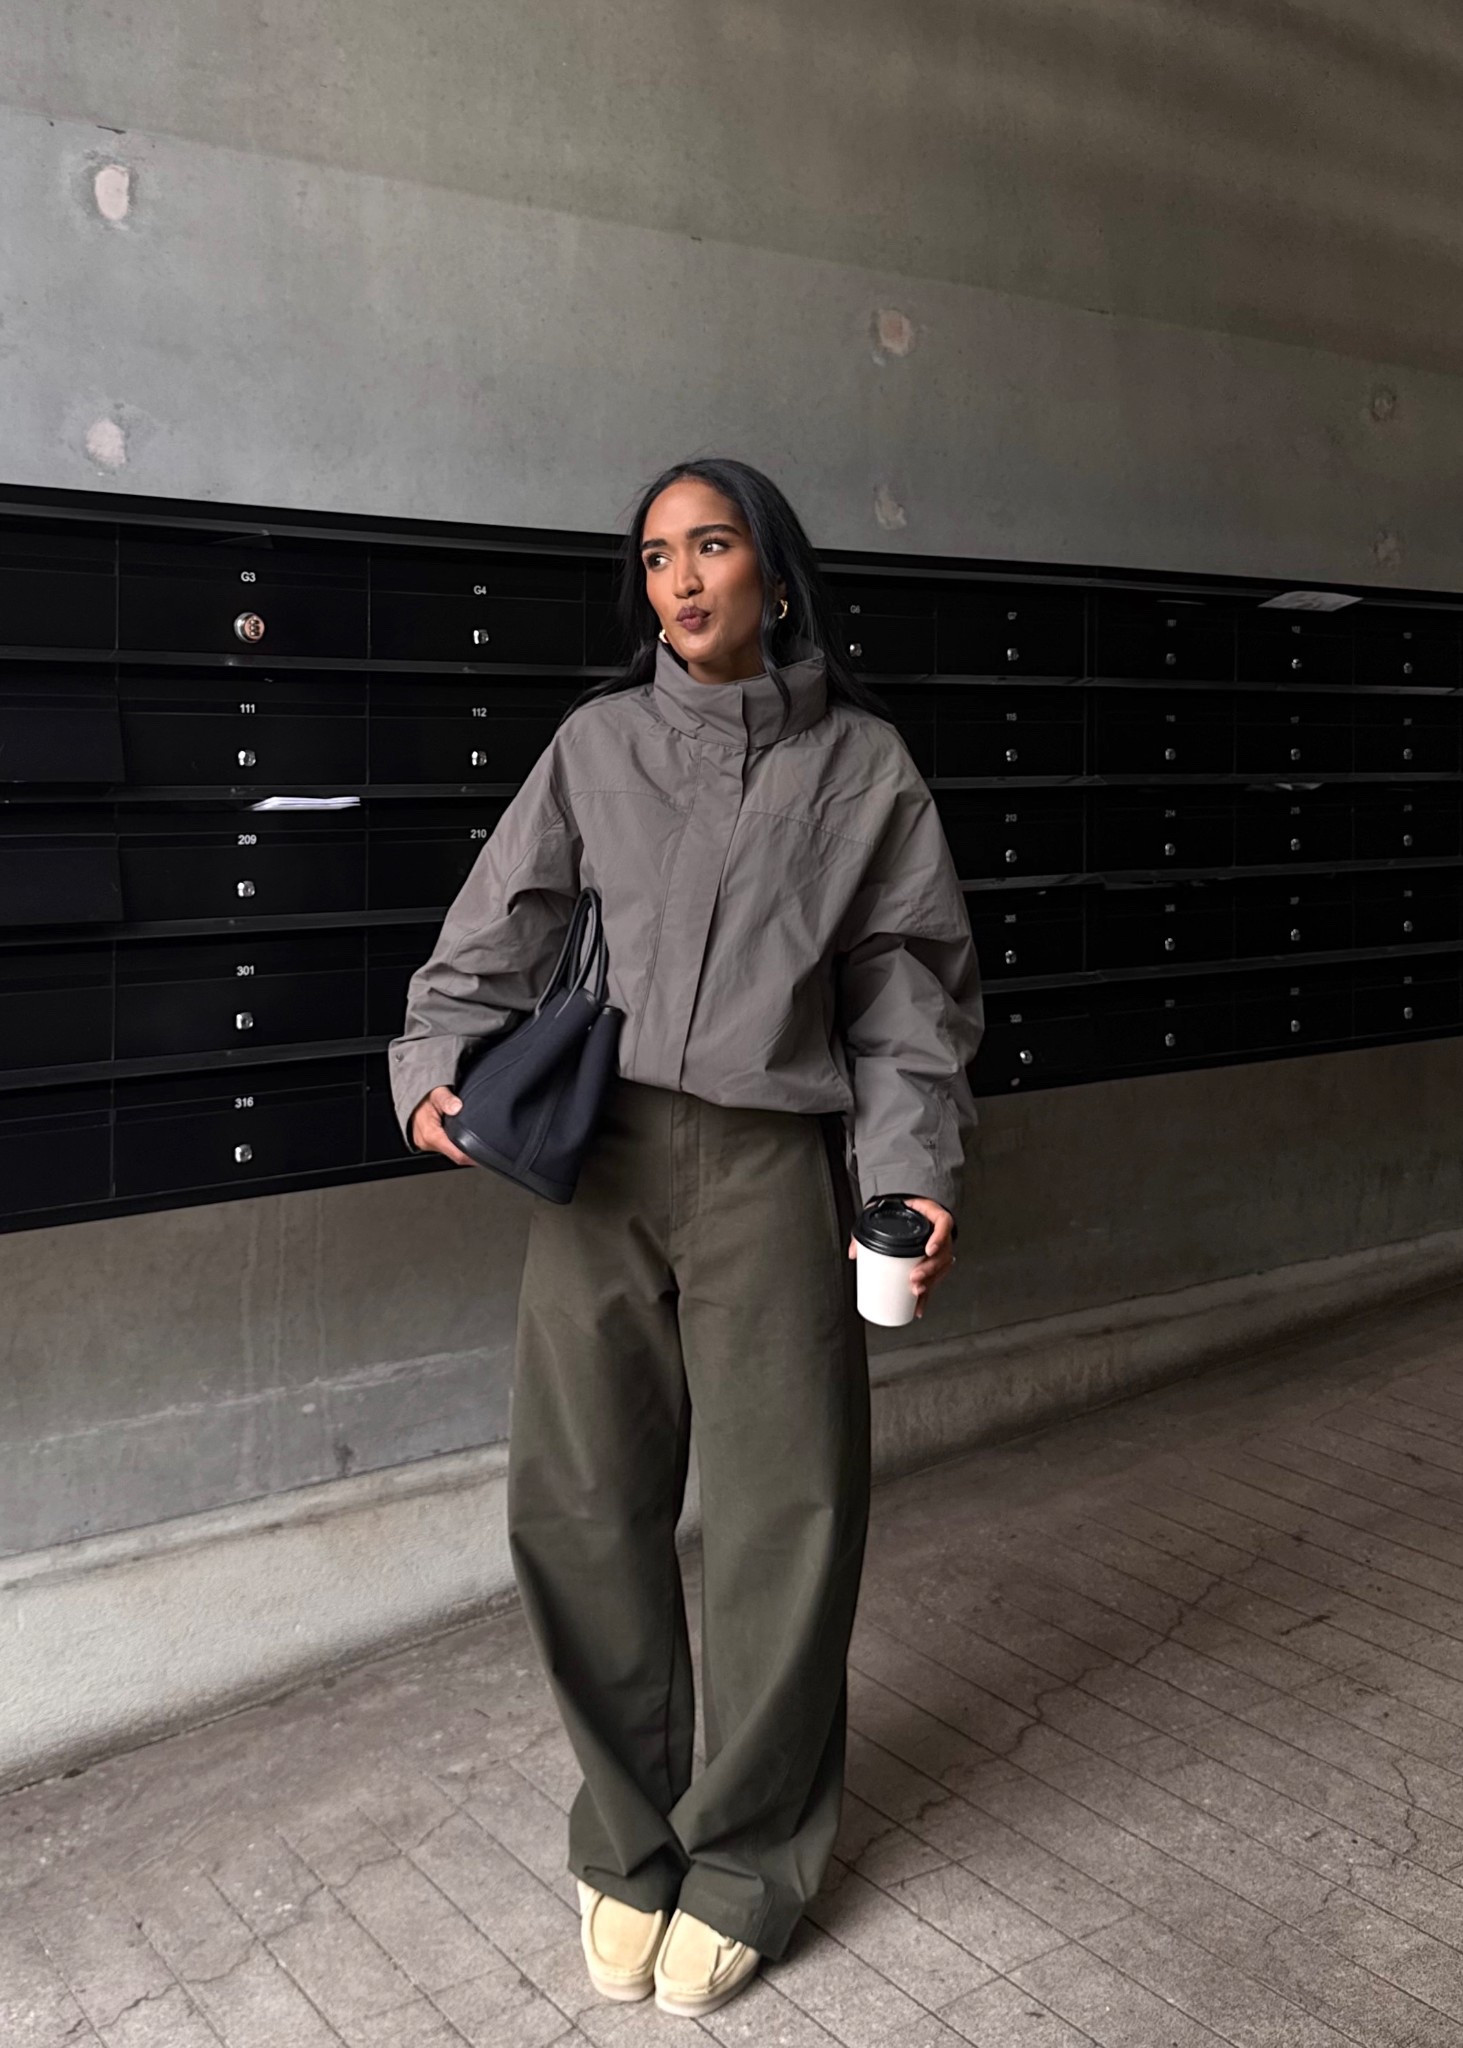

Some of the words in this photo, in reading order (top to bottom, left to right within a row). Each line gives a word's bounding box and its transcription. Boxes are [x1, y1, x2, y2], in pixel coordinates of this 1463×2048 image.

[240, 571, 256, 583] G3
[473, 585, 487, 595] G4
[239, 703, 255, 714] 111
[471, 707, 487, 718] 112
[470, 828, 487, 839] 210
[237, 834, 257, 846] 209
[236, 965, 255, 977] 301
[234, 1096, 254, 1109] 316
